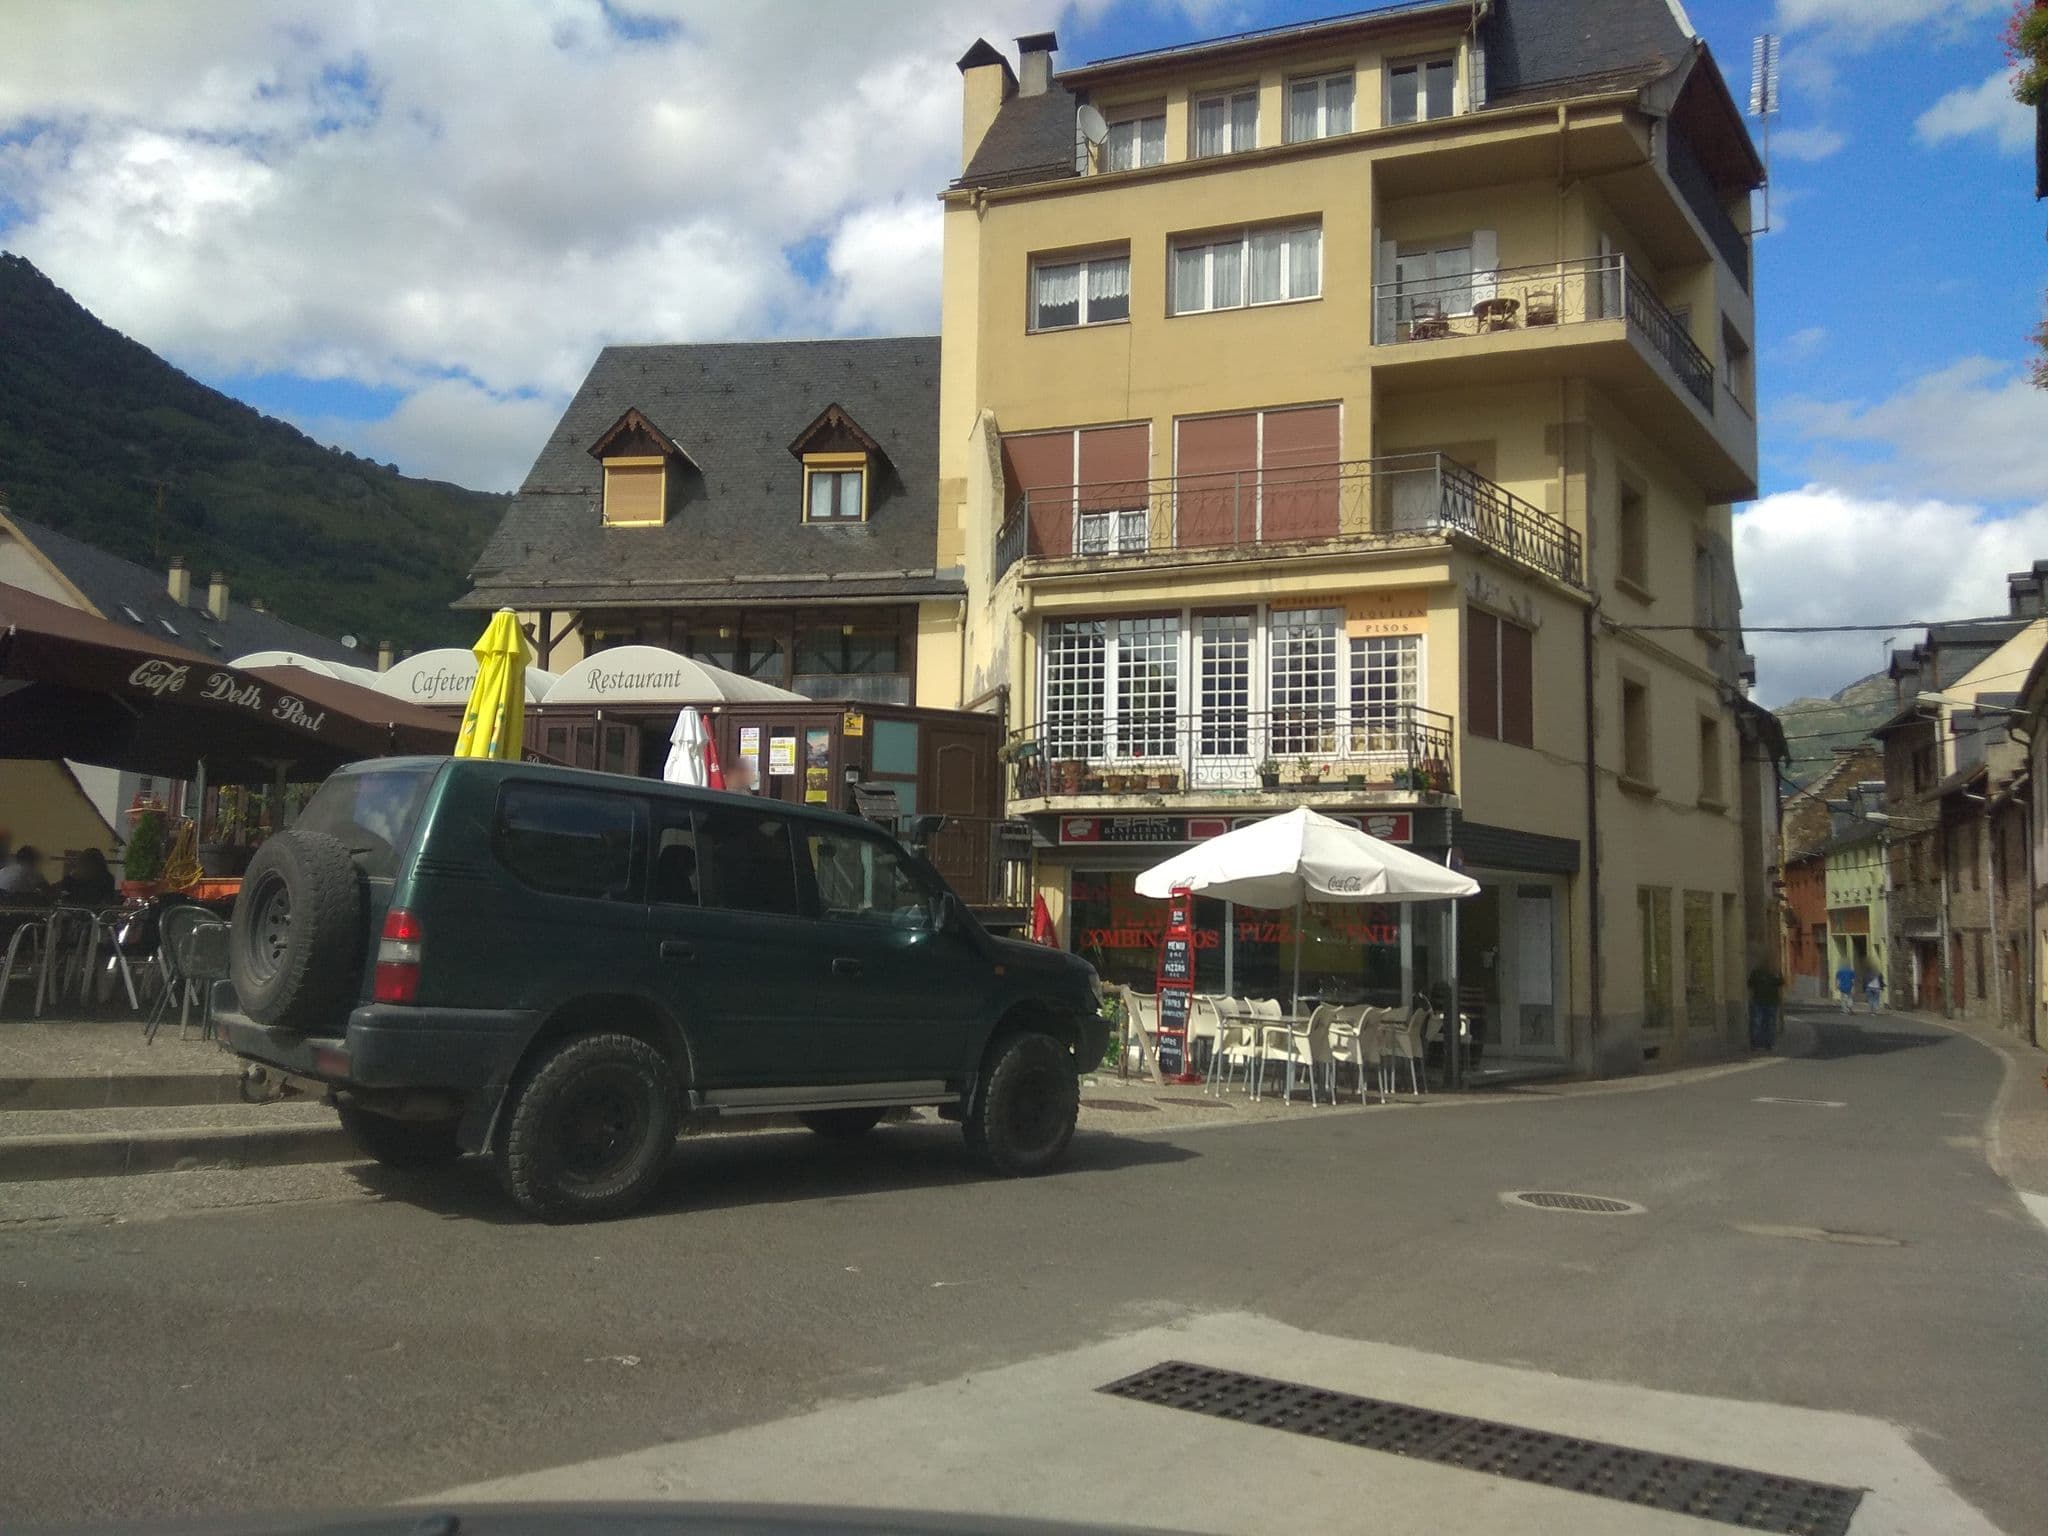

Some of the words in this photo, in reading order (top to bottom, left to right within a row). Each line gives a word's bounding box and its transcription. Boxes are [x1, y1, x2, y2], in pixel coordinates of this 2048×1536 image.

[1365, 623, 1409, 633] PISOS
[411, 667, 478, 699] Cafeteri
[587, 668, 682, 694] Restaurant
[128, 659, 191, 696] Café
[272, 695, 326, 731] Pont
[1113, 815, 1169, 827] BAR
[1079, 927, 1220, 950] COMBINOS
